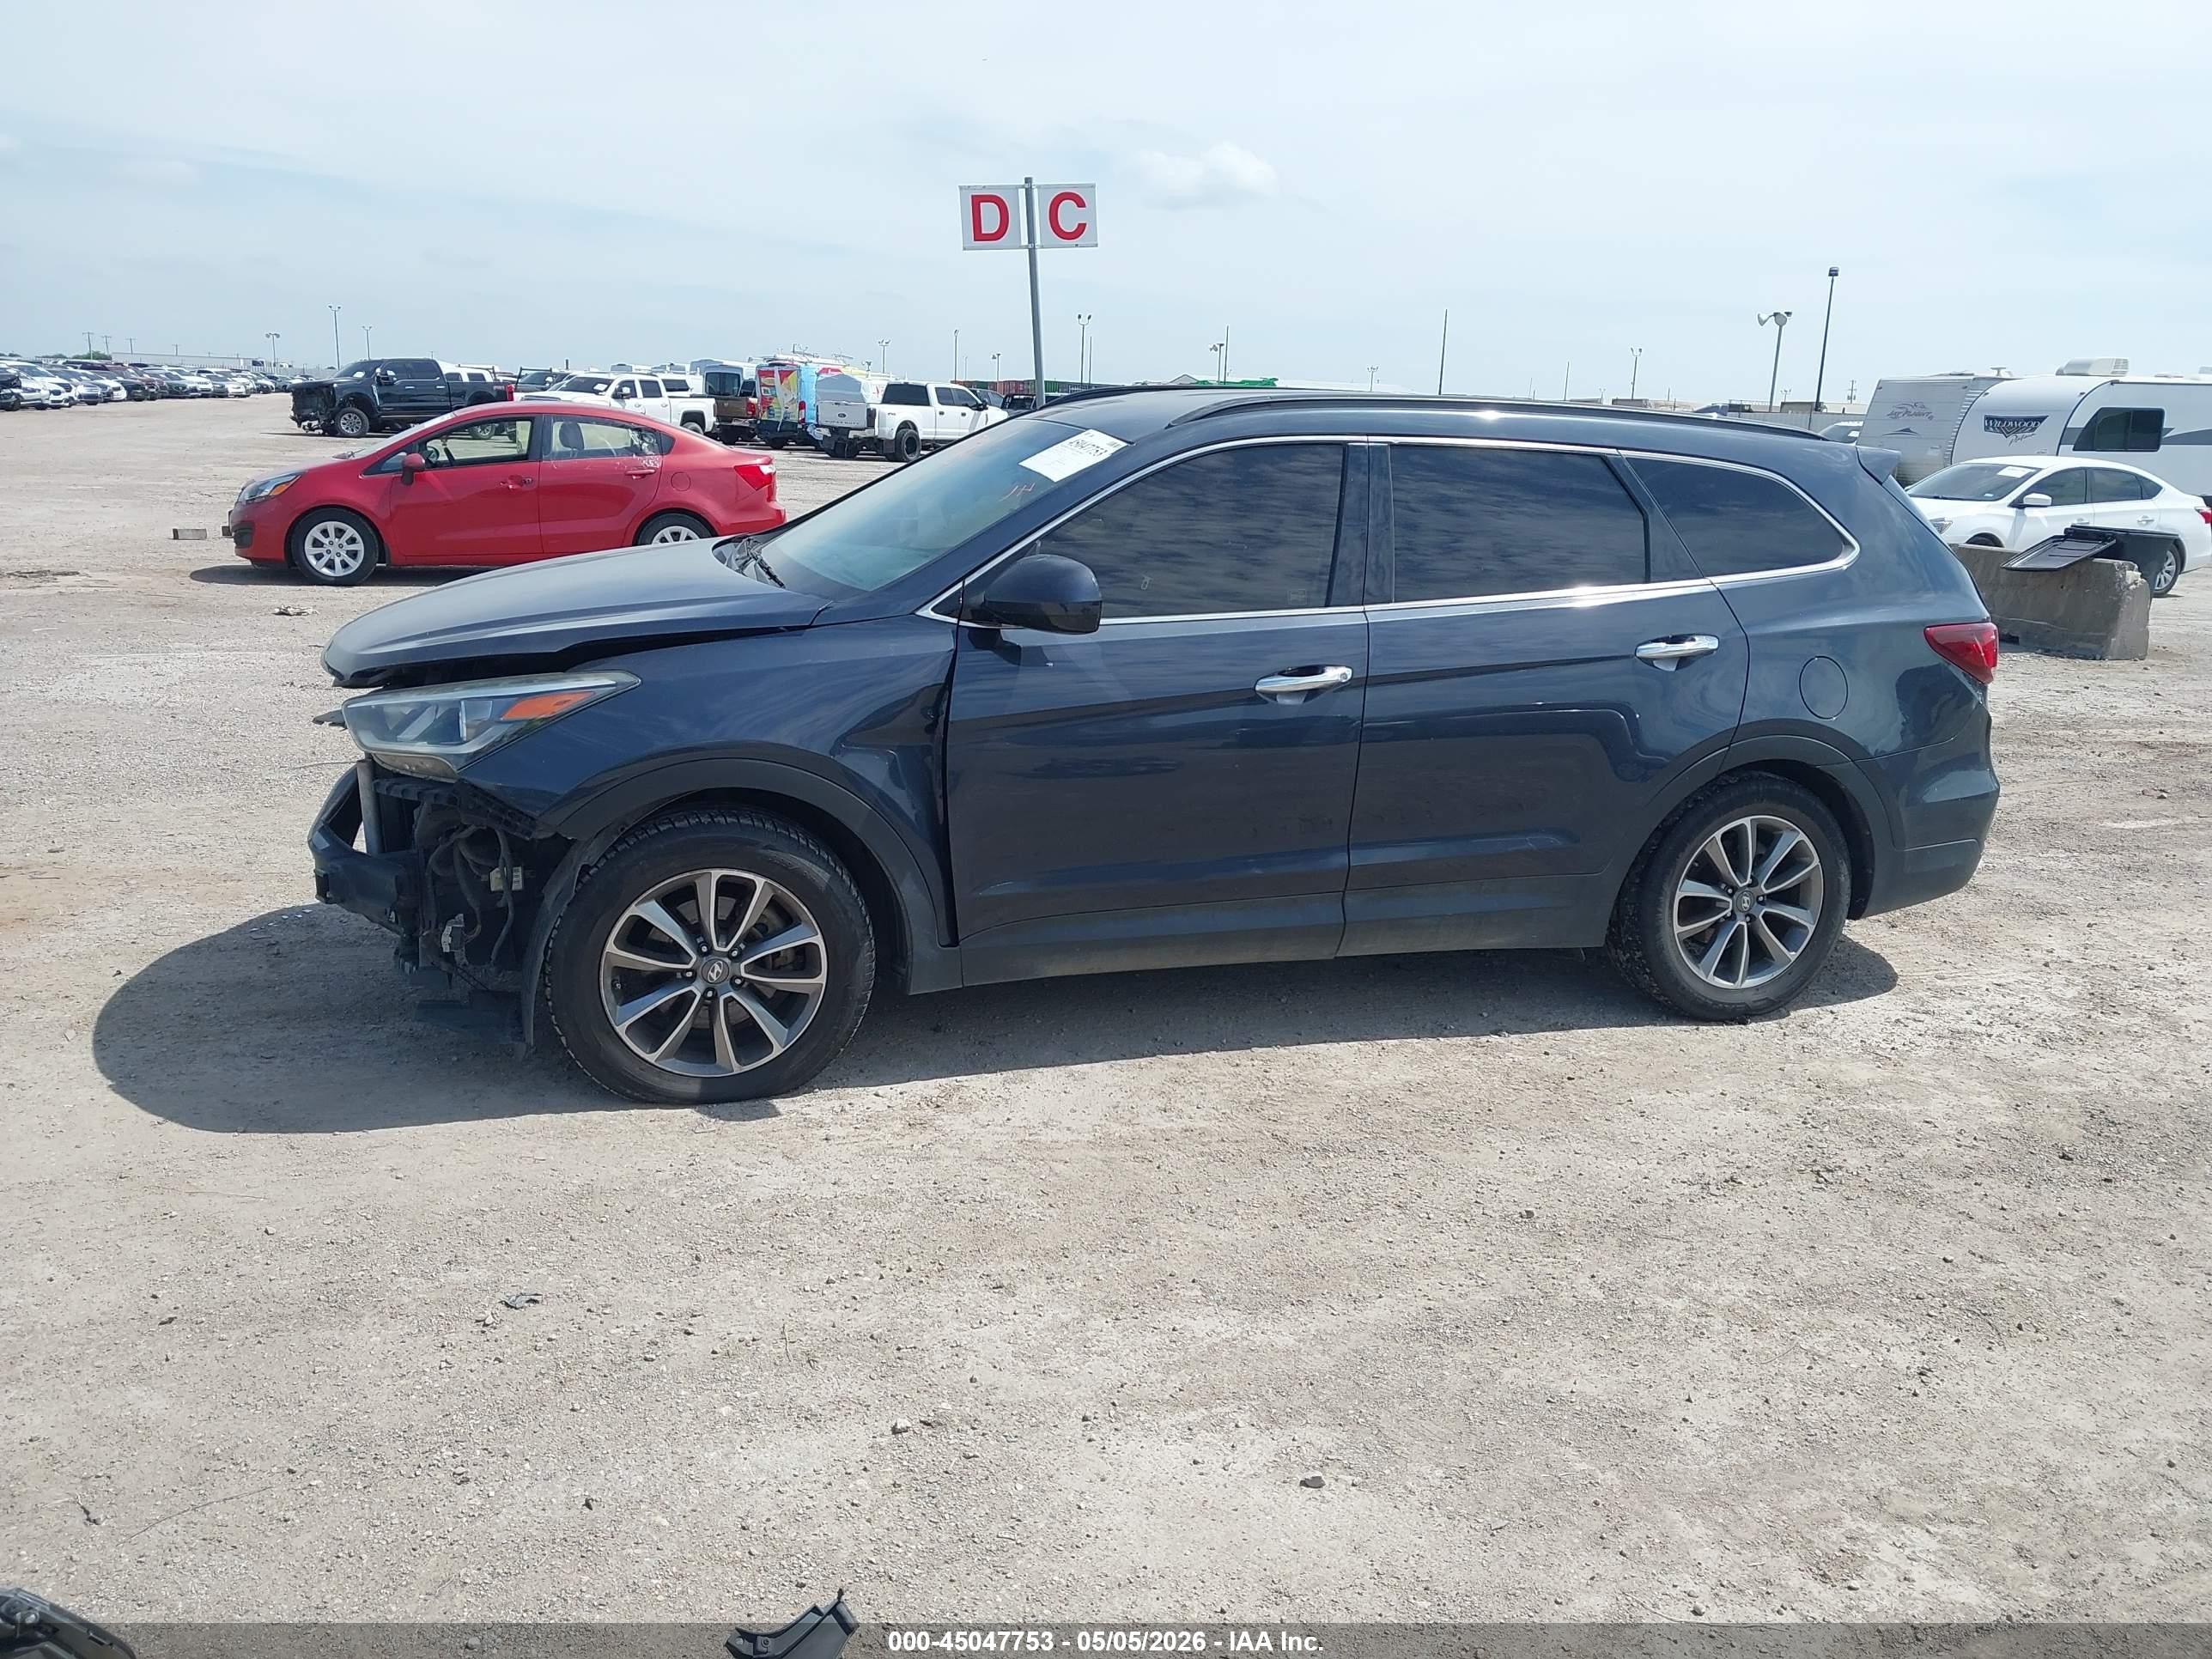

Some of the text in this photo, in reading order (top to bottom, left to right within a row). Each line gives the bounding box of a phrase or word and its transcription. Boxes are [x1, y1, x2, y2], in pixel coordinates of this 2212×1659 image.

[971, 194, 1010, 242] D
[1048, 191, 1087, 240] C
[1984, 419, 2041, 428] WILDWOOD
